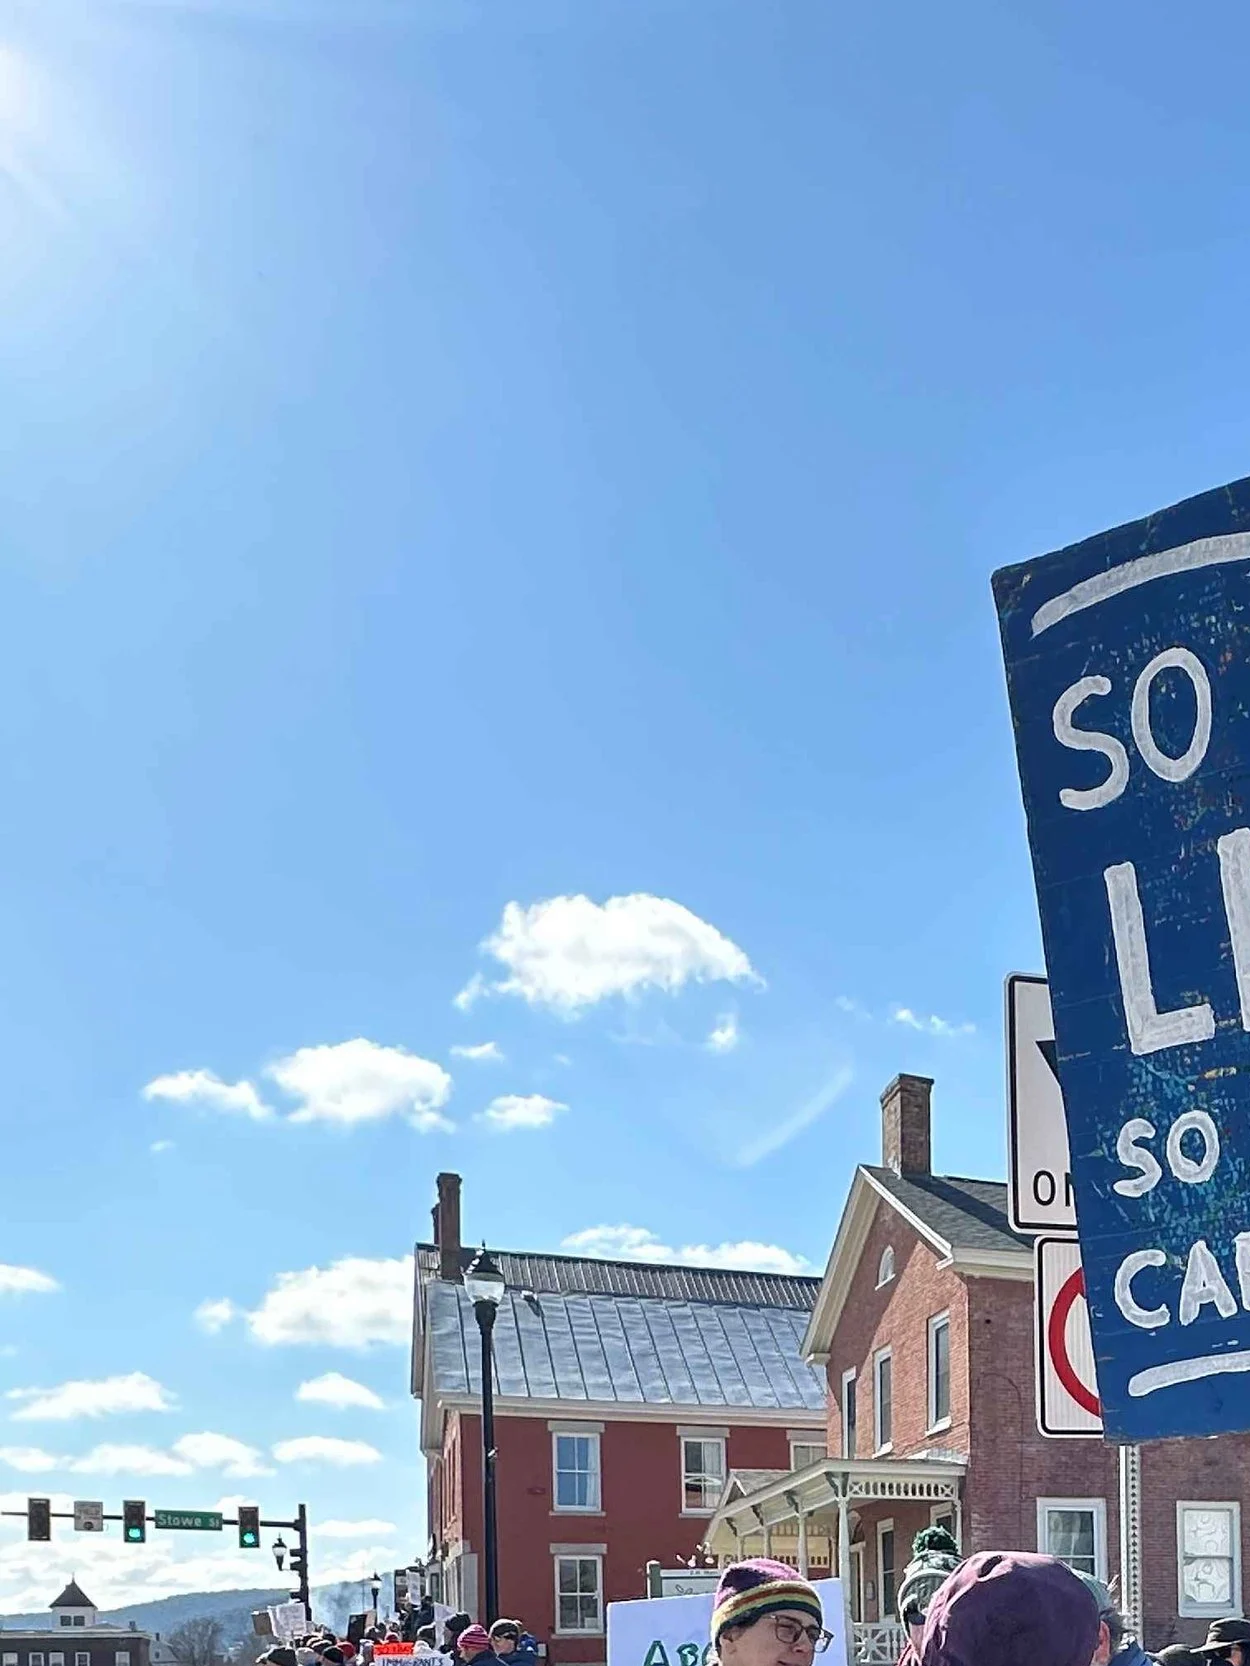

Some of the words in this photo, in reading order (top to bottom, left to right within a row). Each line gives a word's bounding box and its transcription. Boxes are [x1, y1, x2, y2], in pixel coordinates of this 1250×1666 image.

[1053, 647, 1212, 811] SO
[1112, 1109, 1220, 1198] SO
[157, 1513, 202, 1528] Stowe
